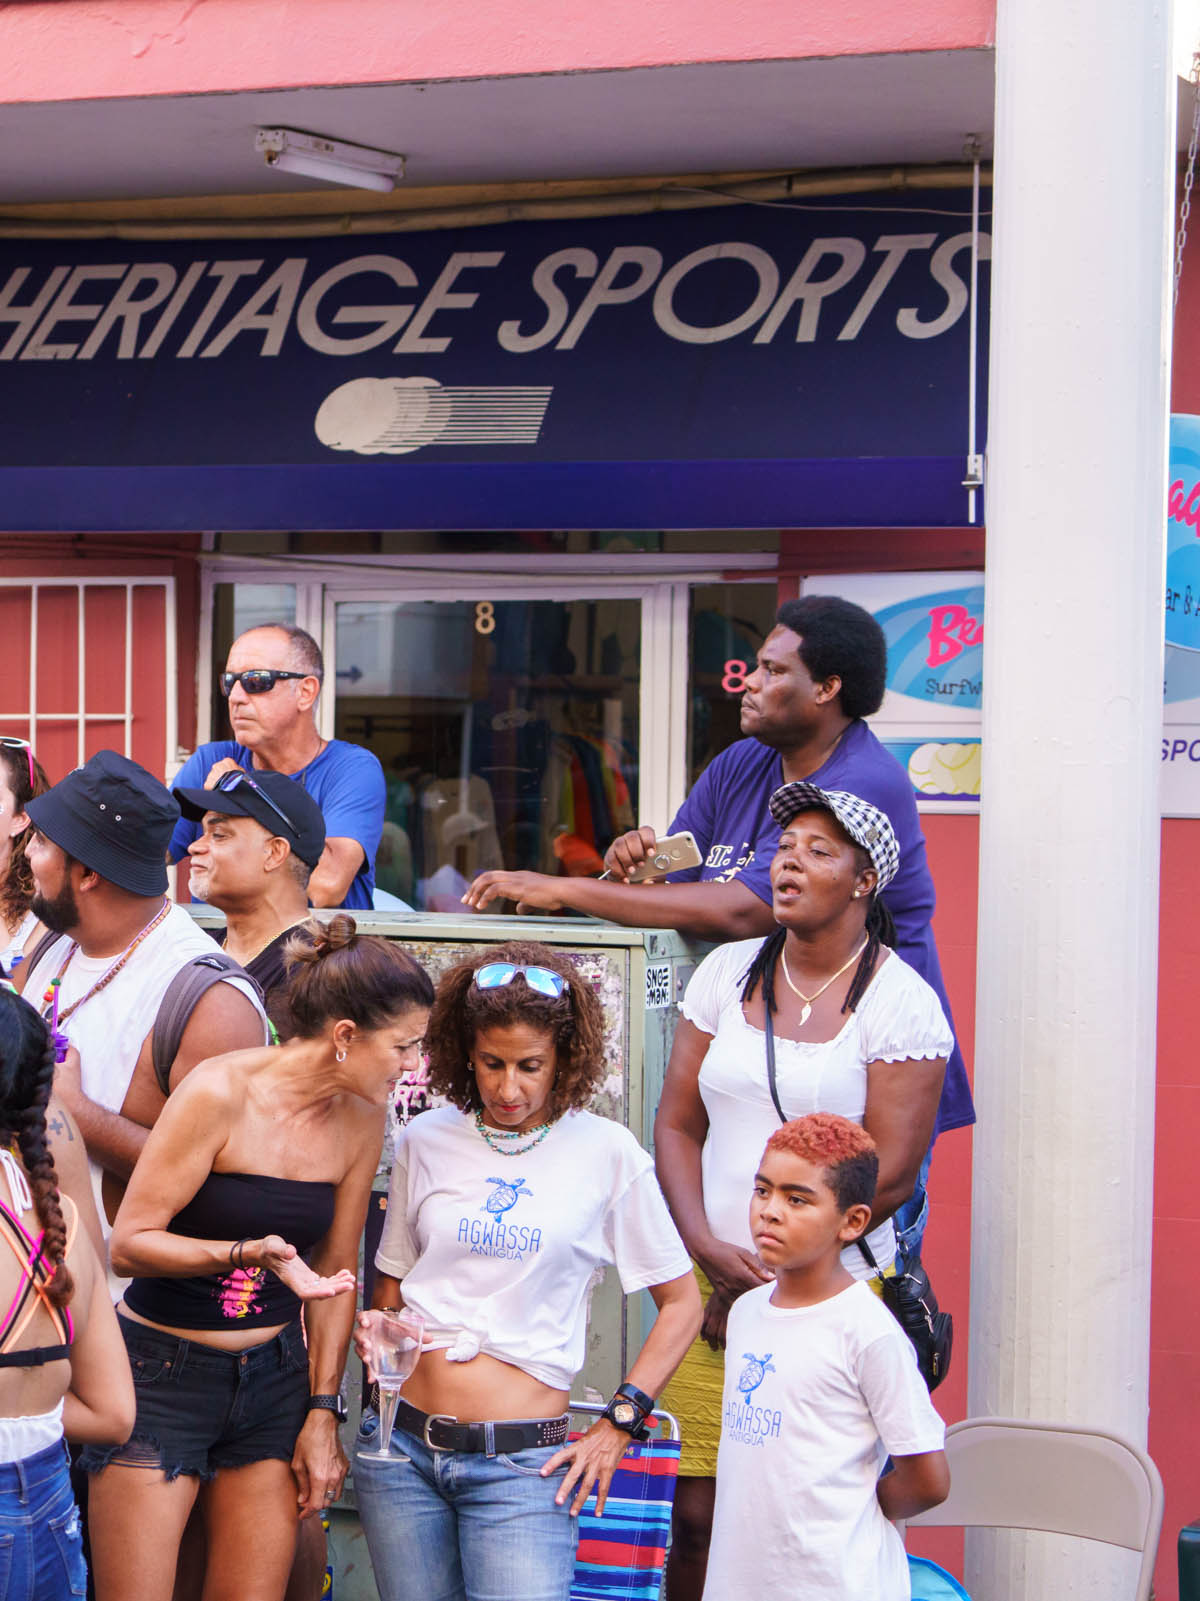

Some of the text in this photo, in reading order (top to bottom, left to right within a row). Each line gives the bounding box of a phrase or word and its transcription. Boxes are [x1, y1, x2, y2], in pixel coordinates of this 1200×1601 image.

[497, 232, 992, 353] SPORTS
[475, 601, 496, 634] 8
[722, 660, 748, 692] 8
[458, 1218, 542, 1253] AGWASSA
[470, 1245, 524, 1263] ANTIGUA
[724, 1401, 782, 1438] AGWASSA
